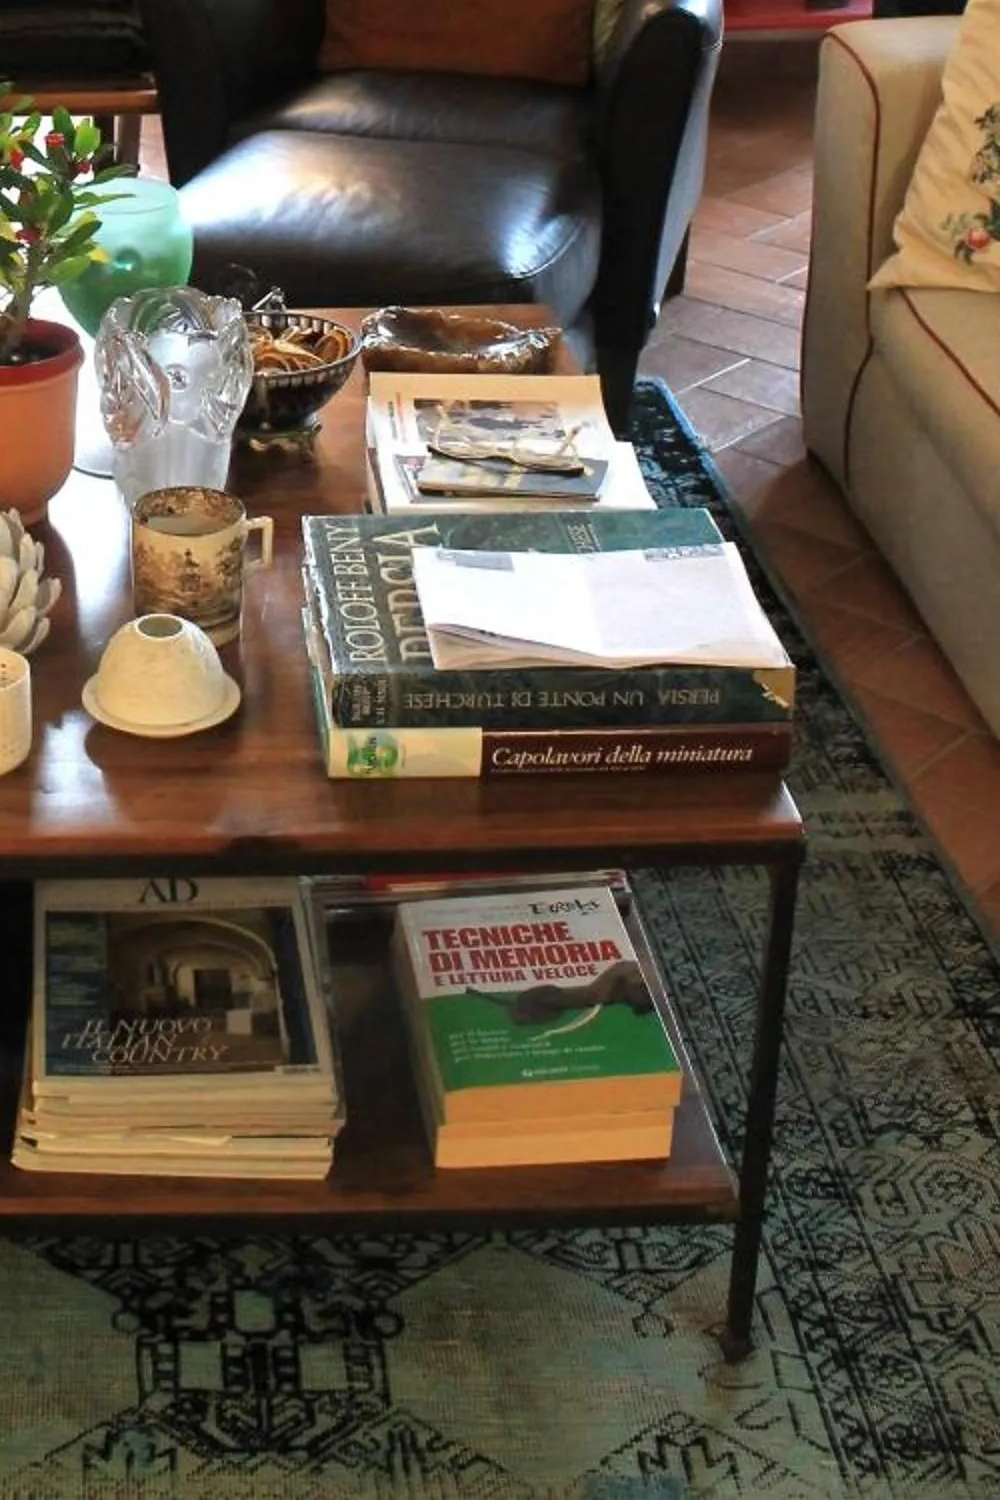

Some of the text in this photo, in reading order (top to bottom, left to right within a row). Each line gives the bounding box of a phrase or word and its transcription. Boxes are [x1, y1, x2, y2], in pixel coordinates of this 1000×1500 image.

[325, 524, 369, 576] BENY
[336, 580, 387, 662] ROLOFF
[403, 688, 720, 709] PERSIA UN PONTE DI TURCHESE
[492, 745, 754, 768] Capolavori della miniatura
[138, 875, 199, 903] AD
[422, 920, 574, 950] TECNICHE
[428, 940, 622, 973] DI MEMORIA
[434, 963, 600, 987] E LETTURA VELOCE
[115, 1017, 212, 1036] NUOVO
[91, 1045, 229, 1063] COUNTRY
